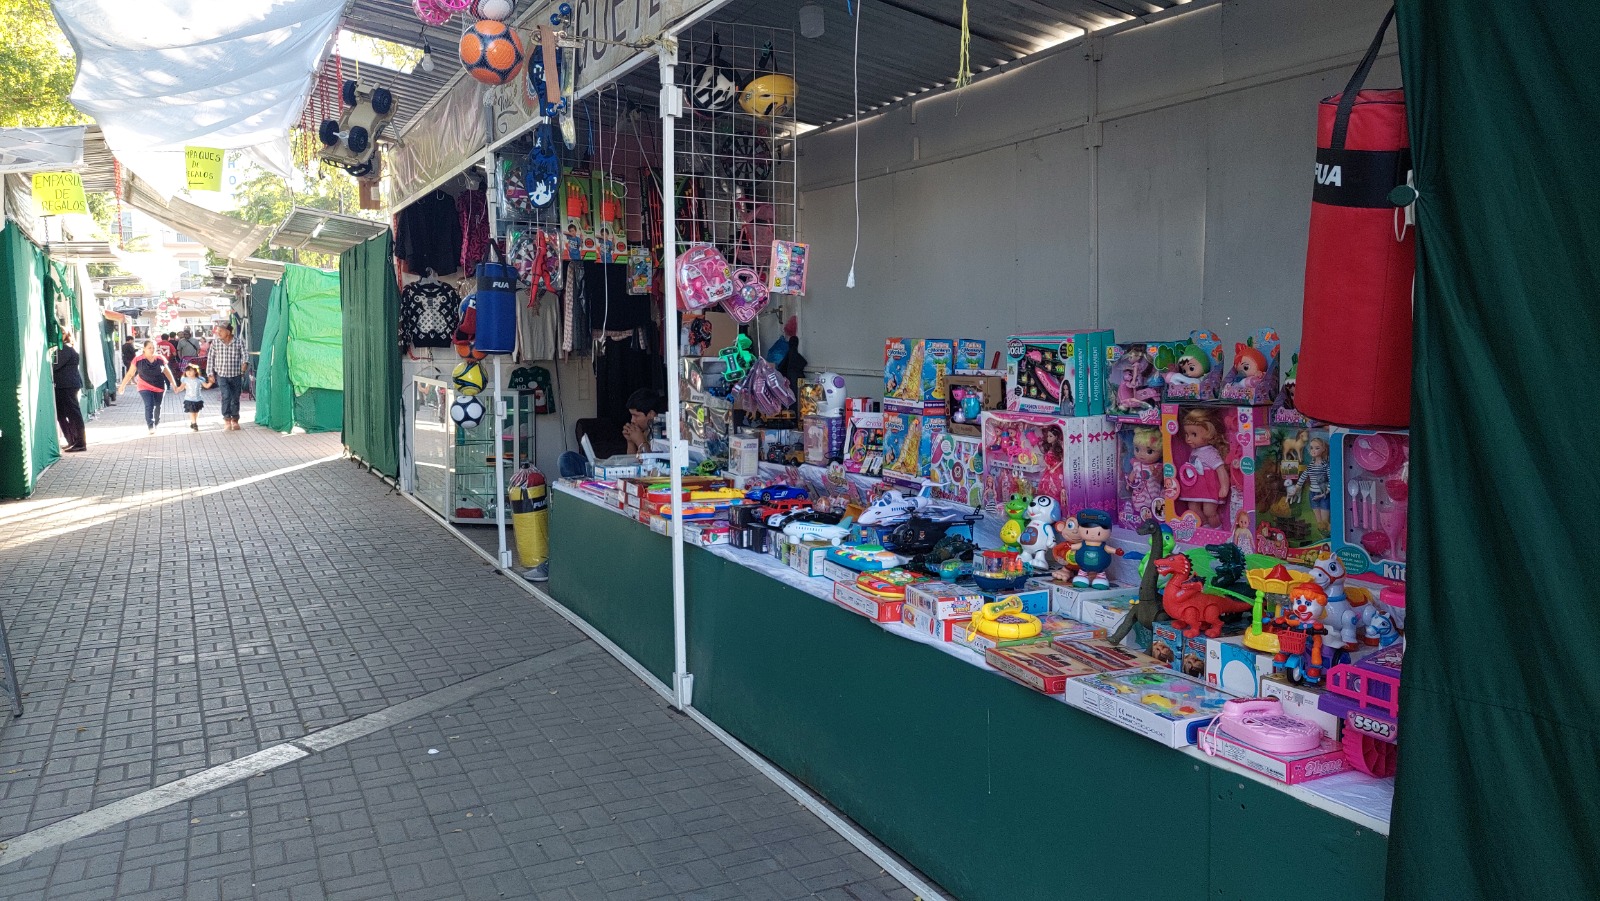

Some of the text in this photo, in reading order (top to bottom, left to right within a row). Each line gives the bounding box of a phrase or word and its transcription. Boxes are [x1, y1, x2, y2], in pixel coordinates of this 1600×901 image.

[186, 170, 214, 179] EGALOS
[55, 188, 71, 200] DE
[41, 200, 86, 211] REGALOS
[492, 281, 510, 289] FUA
[1383, 563, 1406, 582] Kit
[1354, 714, 1390, 737] 5502
